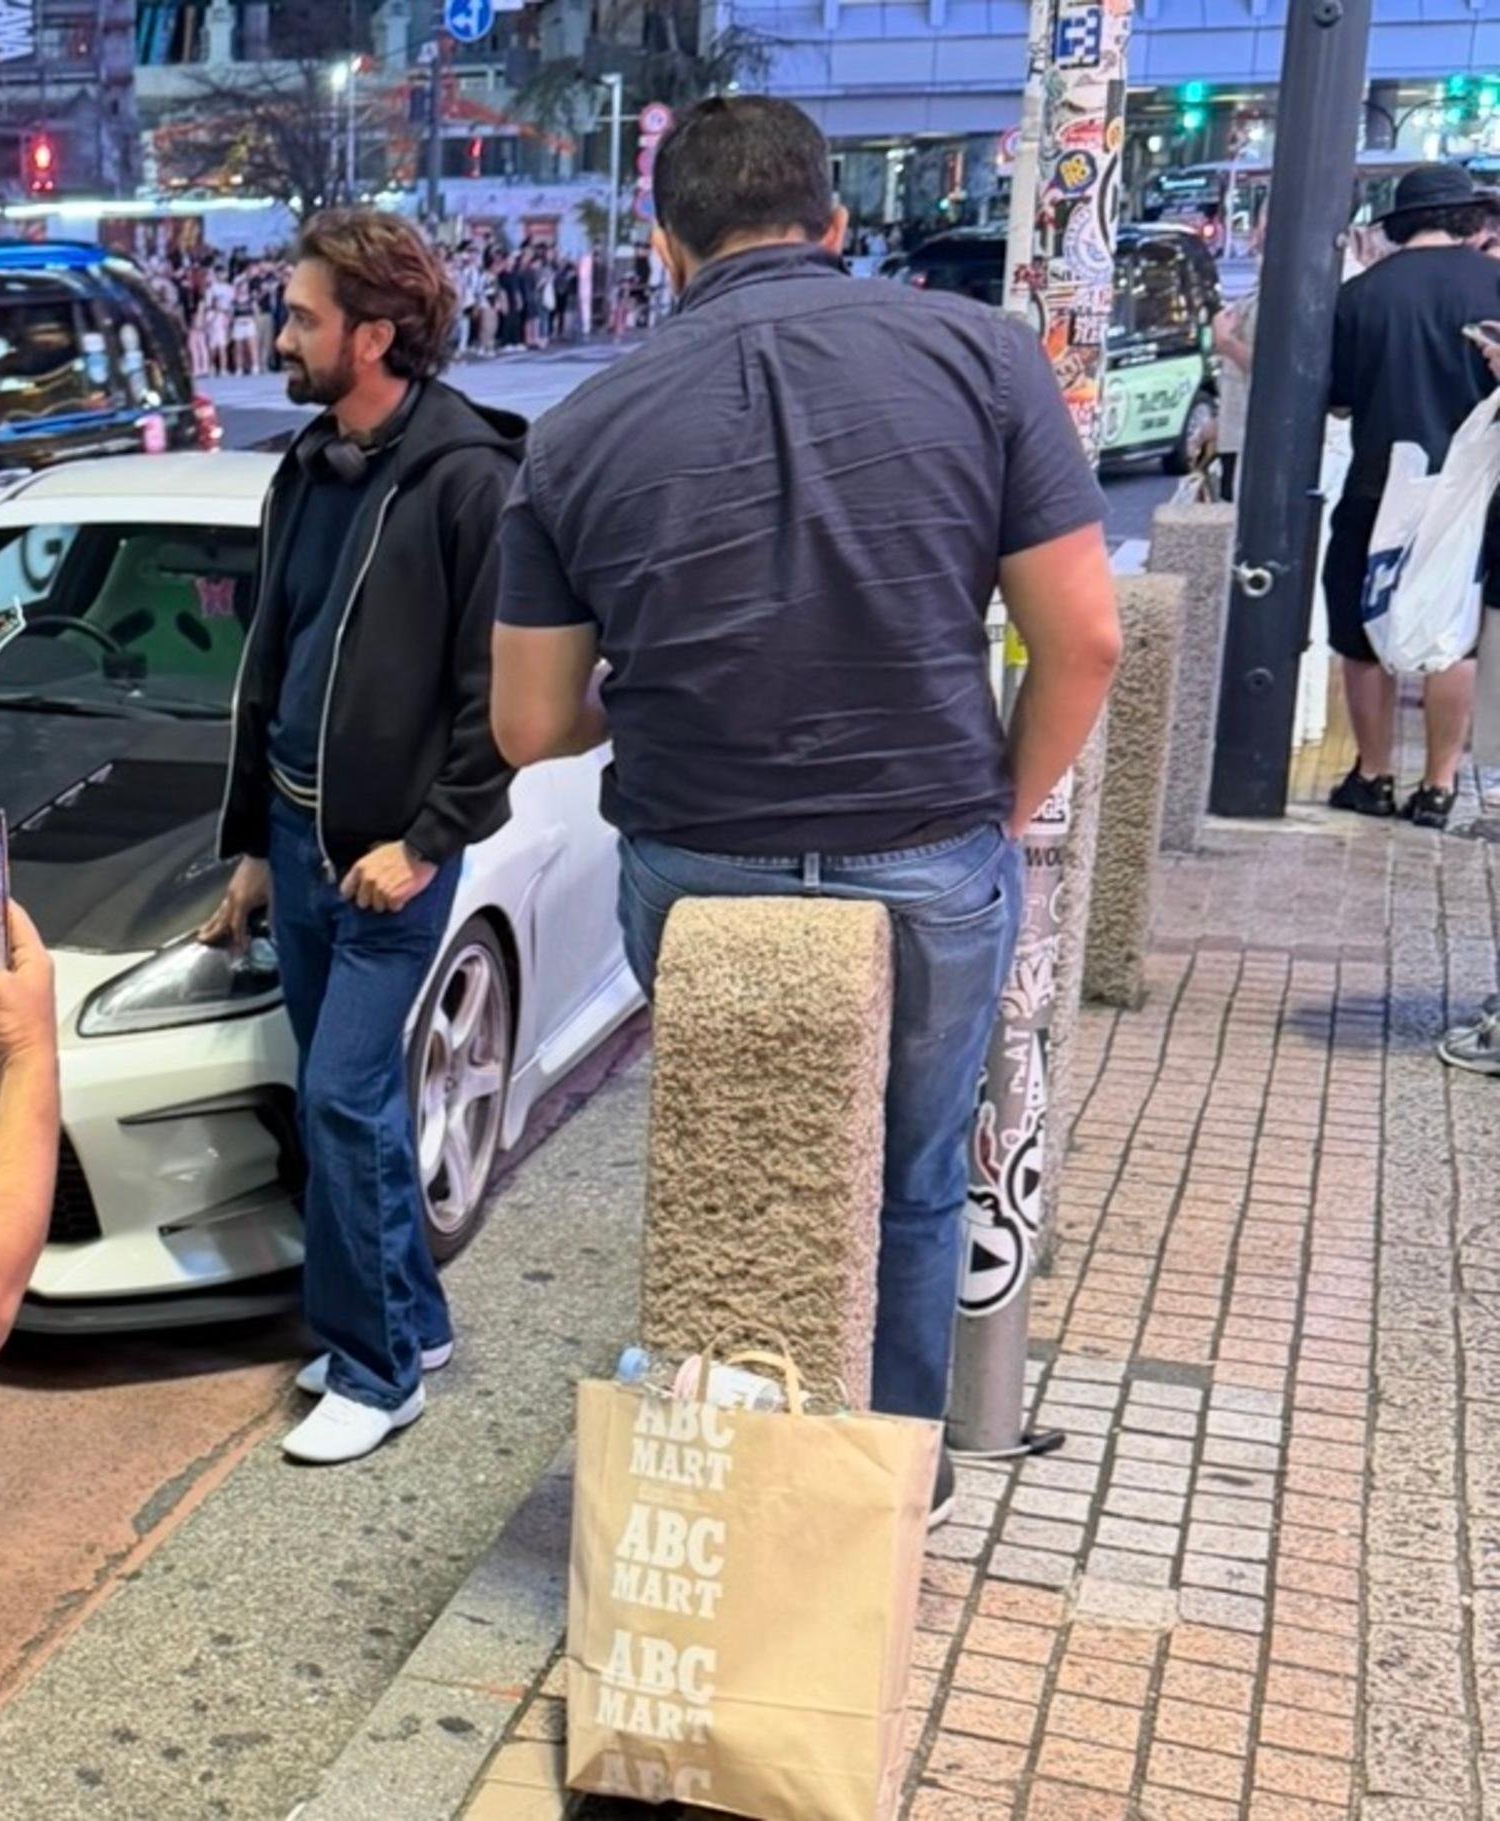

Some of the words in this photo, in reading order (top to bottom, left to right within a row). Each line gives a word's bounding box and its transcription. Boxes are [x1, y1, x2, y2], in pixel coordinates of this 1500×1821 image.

[633, 1397, 736, 1449] ABC
[628, 1437, 733, 1491] MART
[615, 1502, 726, 1578] ABC
[611, 1561, 724, 1620] MART
[601, 1628, 717, 1705] ABC
[594, 1685, 715, 1744] MART
